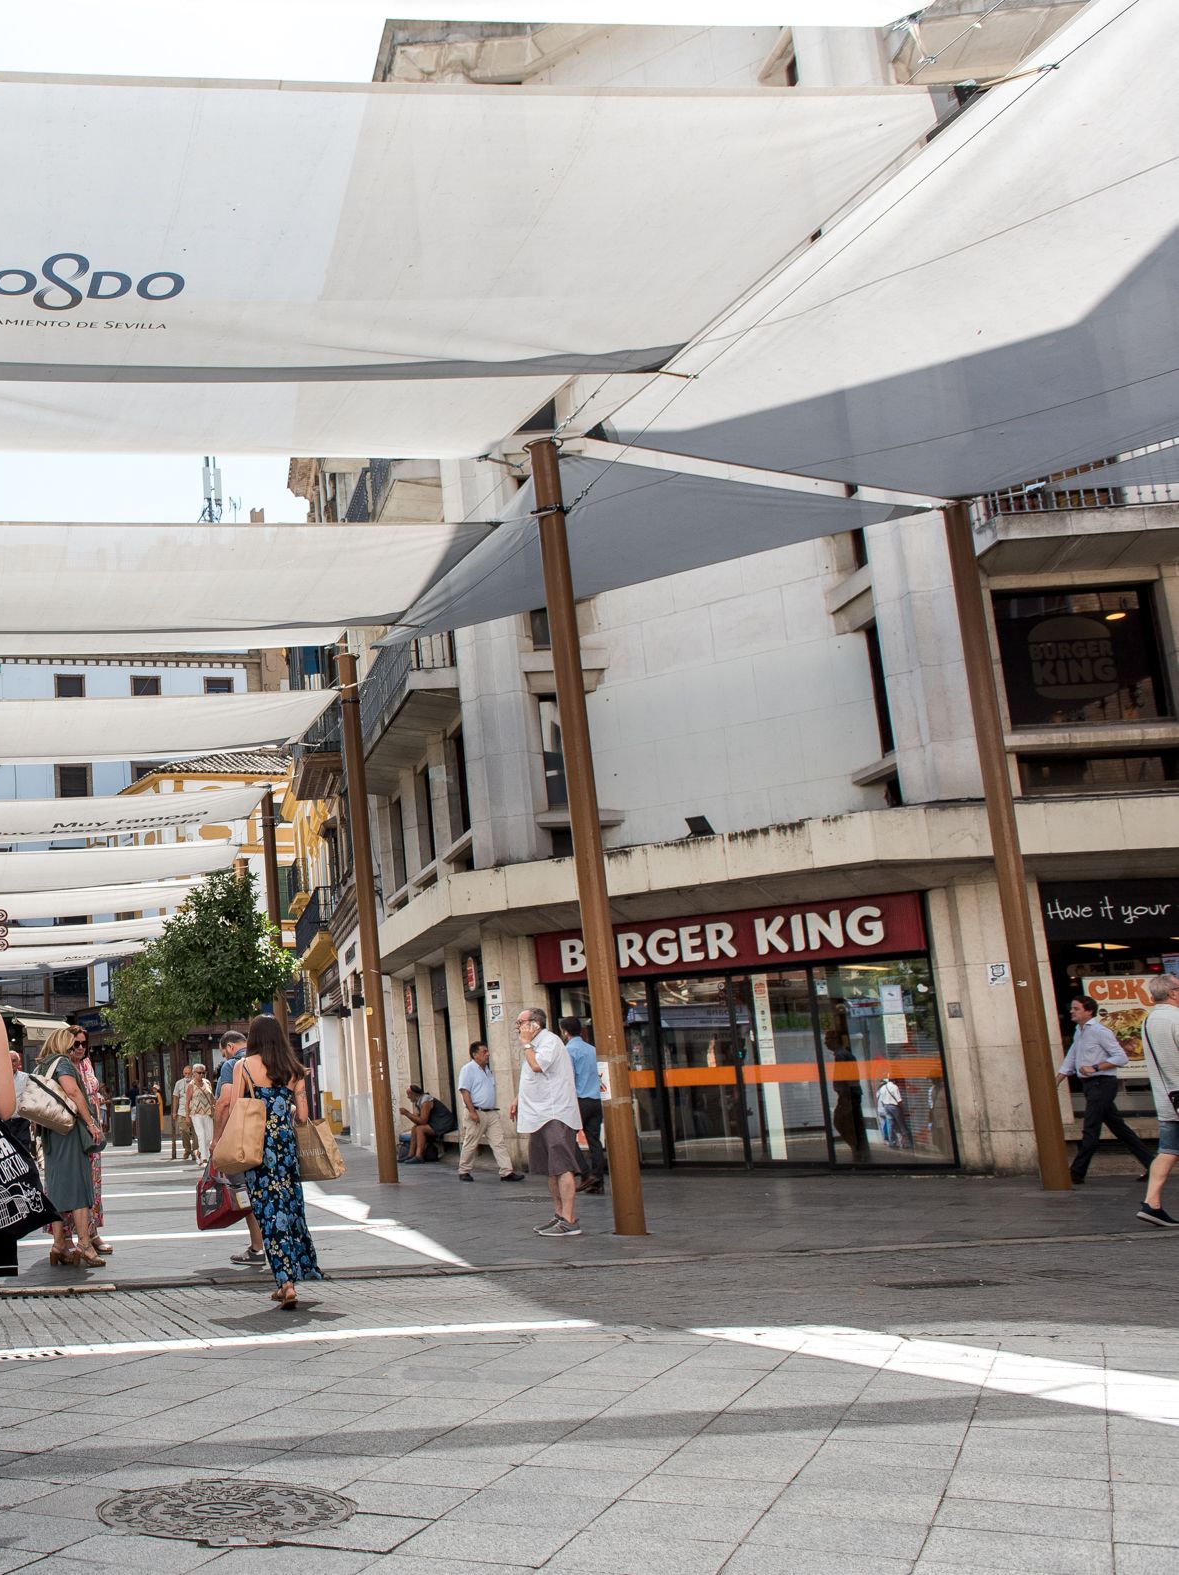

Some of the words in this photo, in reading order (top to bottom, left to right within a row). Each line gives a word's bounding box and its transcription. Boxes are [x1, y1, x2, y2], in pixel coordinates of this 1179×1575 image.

[76, 321, 98, 329] DE
[103, 320, 167, 330] SEVILLA
[1028, 640, 1114, 661] BURGER
[1032, 657, 1118, 685] KING
[52, 821, 109, 829] Muy
[117, 810, 209, 825] famosa
[1047, 899, 1093, 920] Have
[1099, 896, 1114, 920] it
[1121, 902, 1171, 924] your
[560, 922, 737, 974] BRGER
[754, 906, 884, 955] KING
[1088, 978, 1155, 1007] CBK
